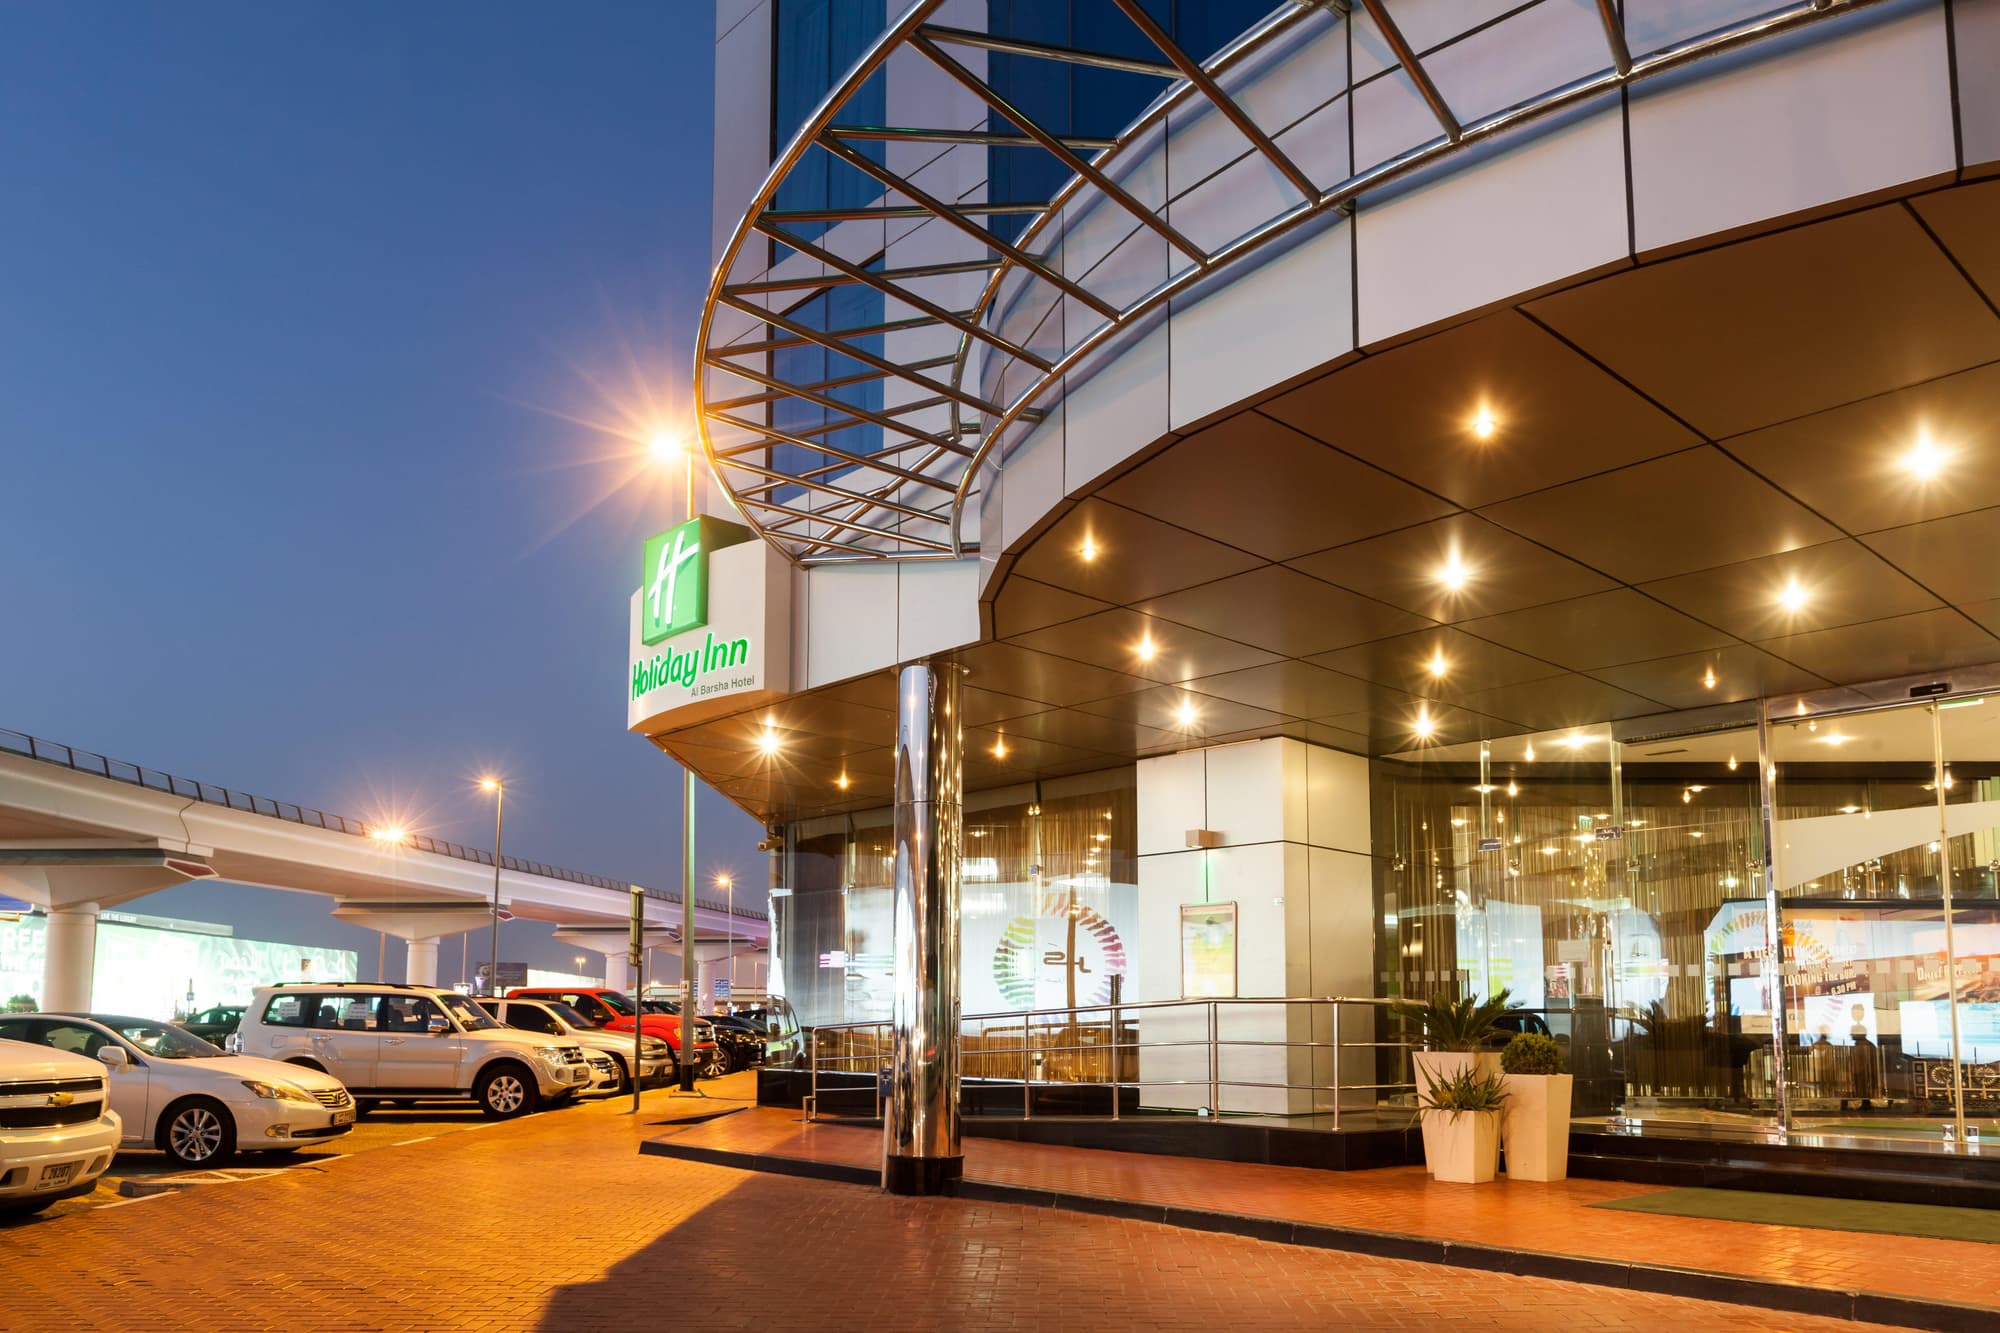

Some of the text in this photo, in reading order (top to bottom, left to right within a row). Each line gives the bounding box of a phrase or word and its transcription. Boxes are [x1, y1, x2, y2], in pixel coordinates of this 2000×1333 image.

[632, 632, 748, 701] Holiday Inn
[691, 675, 755, 697] Al Barsha Hotel
